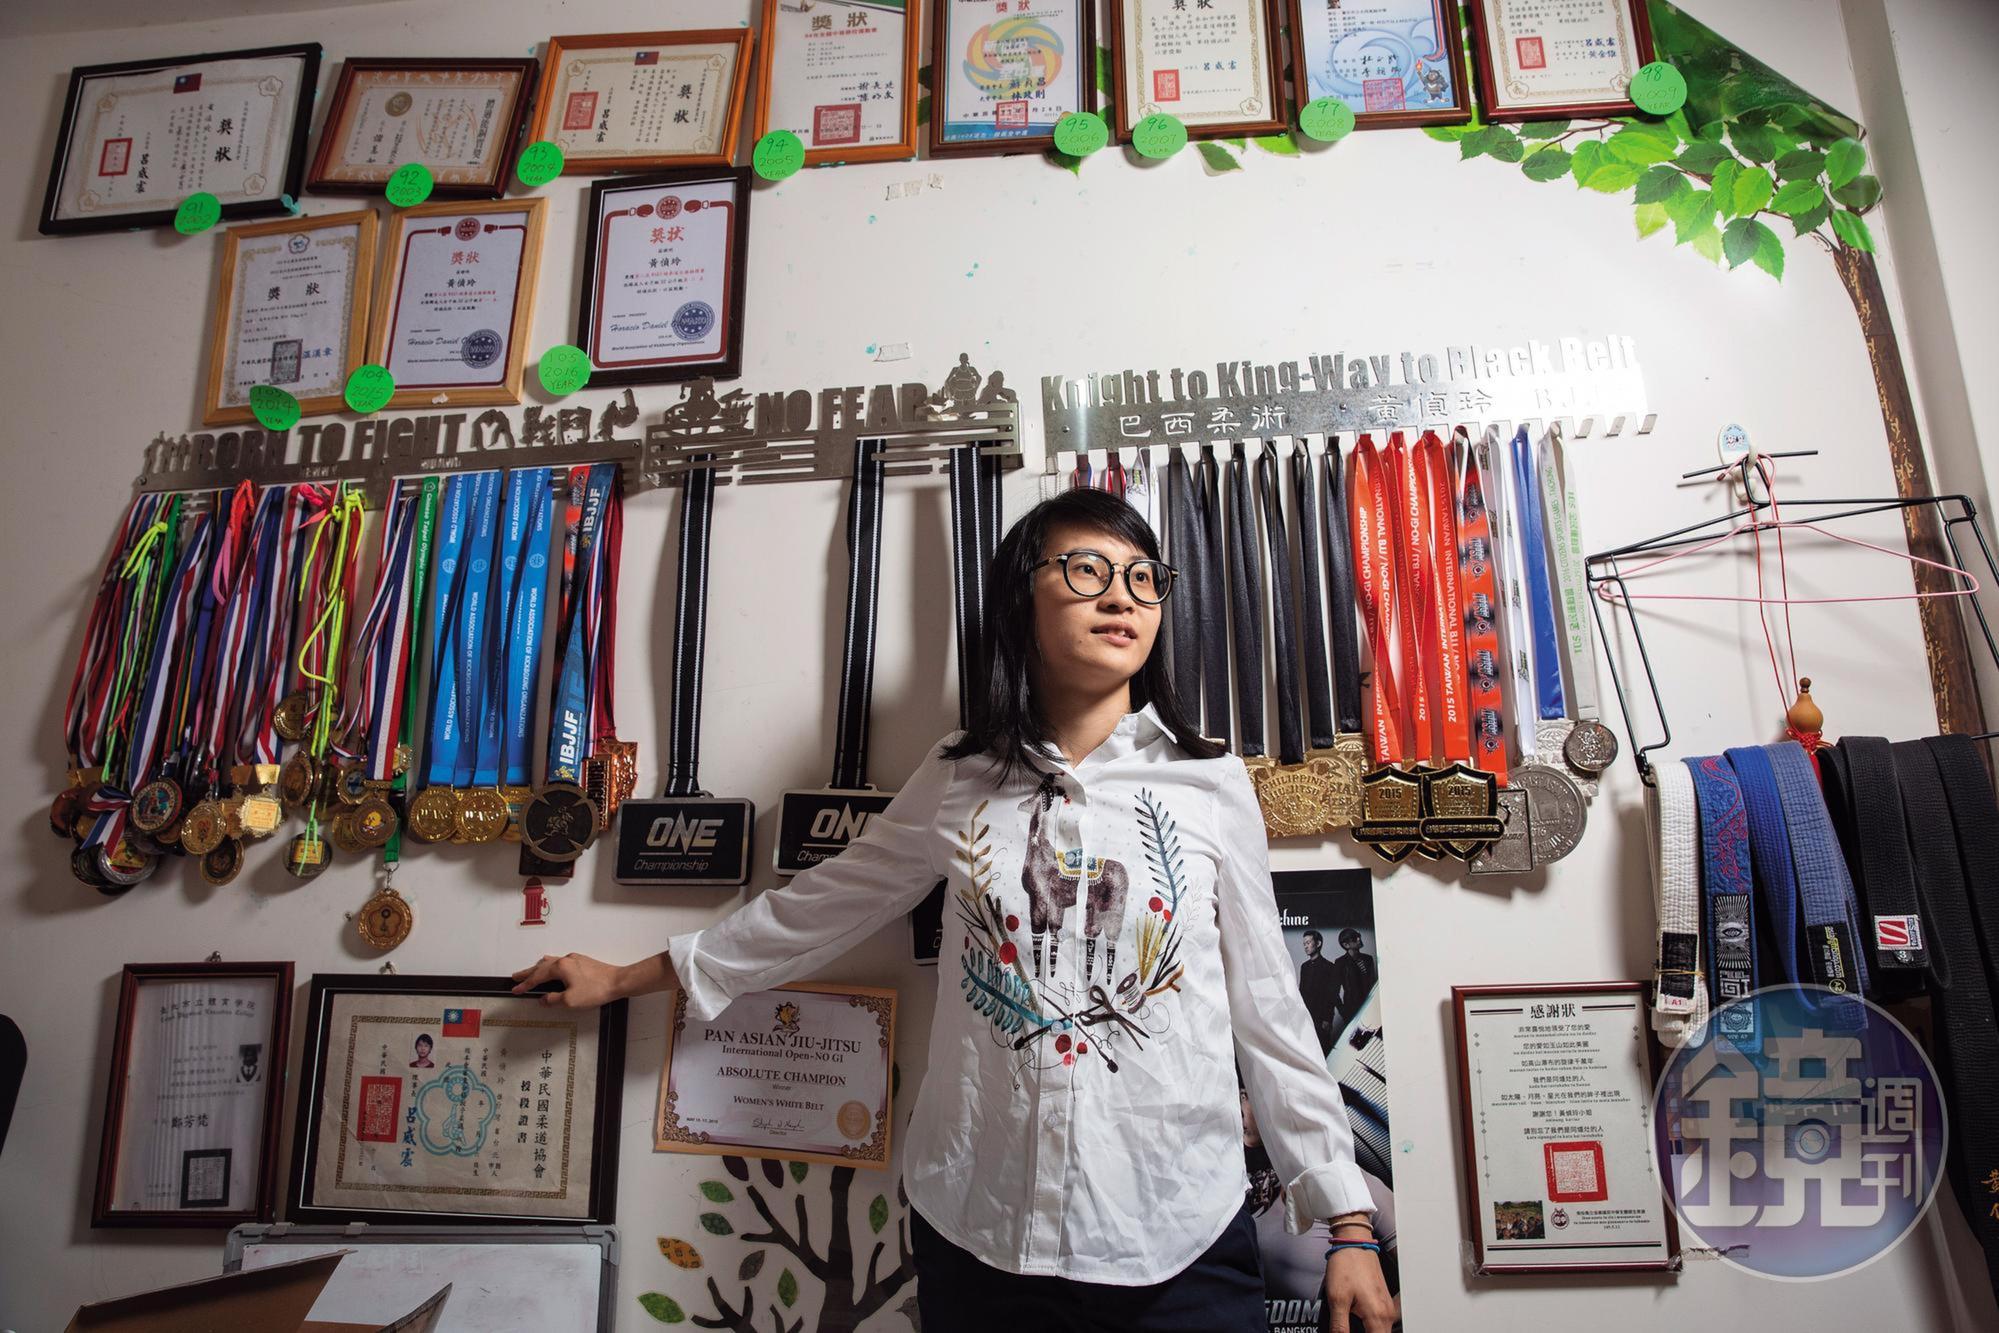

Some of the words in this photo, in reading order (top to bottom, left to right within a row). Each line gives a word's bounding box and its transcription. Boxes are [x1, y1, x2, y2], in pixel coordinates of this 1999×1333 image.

[1316, 102, 1341, 116] 97
[1065, 117, 1089, 133] 95
[1146, 117, 1168, 132] 96
[765, 137, 789, 155] 94
[759, 155, 794, 167] 2005
[399, 169, 420, 187] 92
[650, 226, 685, 245] 獎狀
[450, 250, 481, 267] 獎狀
[544, 366, 579, 378] 2016
[1041, 369, 1163, 411] Knight
[1170, 367, 1209, 401] to
[1400, 351, 1441, 385] to
[755, 391, 813, 434] NO
[820, 383, 929, 430] FEAR
[1367, 388, 1498, 422] 黃偵玲
[1119, 404, 1287, 438] 巴西柔術
[195, 431, 291, 470] BORN
[301, 423, 348, 464] TO
[356, 413, 467, 462] FIGHT
[424, 493, 433, 519] Chinese
[582, 488, 601, 532] IBJJF
[1409, 516, 1420, 546] NO-GI
[1359, 506, 1372, 580] CHAMPIONSHIP
[530, 587, 538, 608] WORLD
[1446, 549, 1458, 630] INTERNATIONAL
[526, 608, 537, 646] ASSOCIATION
[1443, 654, 1455, 696] TAIWAN
[1418, 697, 1426, 721] 2015
[1447, 698, 1457, 722] 2015
[444, 719, 453, 740] WORLD
[559, 709, 580, 766] IBJJF
[1378, 720, 1391, 762] TAIWAN
[1262, 773, 1328, 793] PHILIPPINE
[1378, 788, 1403, 800] 2015
[1448, 785, 1473, 797] 2015
[646, 809, 725, 855] ONE
[633, 858, 710, 873] Championship
[1530, 1003, 1577, 1019] 感謝狀
[1671, 999, 1683, 1007] A1
[703, 1029, 735, 1043] PAN
[739, 1031, 787, 1046] ASIAN
[789, 1034, 862, 1053] JIU-JITSU
[722, 1045, 783, 1059] International
[785, 1050, 831, 1063] Open-NO
[831, 1054, 844, 1064] GI
[716, 1066, 781, 1081] ABSOLUTE
[783, 1071, 847, 1086] CHAMPION
[516, 1079, 532, 1145] 授段證書
[532, 1050, 554, 1180] 中華民國柔道協會
[733, 1096, 775, 1107] WOMEN'S
[775, 1098, 804, 1111] WHITE
[804, 1101, 825, 1112] BELT
